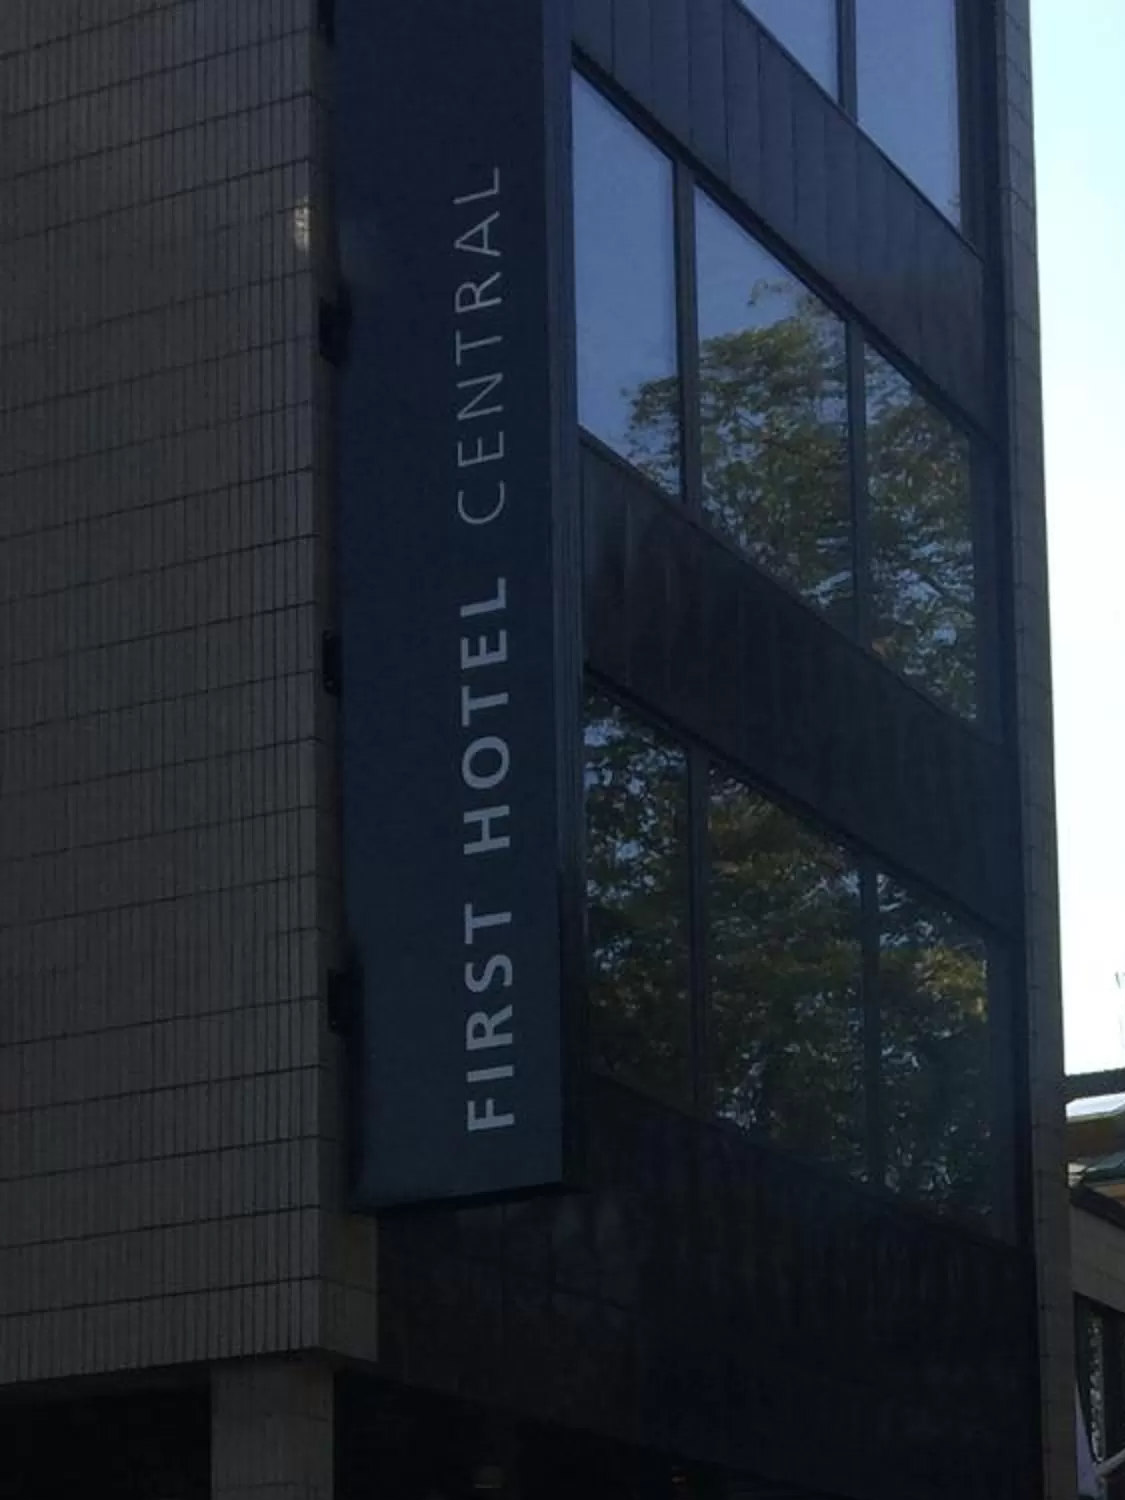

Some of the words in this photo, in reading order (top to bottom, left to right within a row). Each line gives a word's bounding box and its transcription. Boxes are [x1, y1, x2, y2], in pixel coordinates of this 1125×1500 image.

[452, 167, 506, 525] CENTRAL
[460, 577, 511, 855] HOTEL
[464, 903, 516, 1132] FIRST
